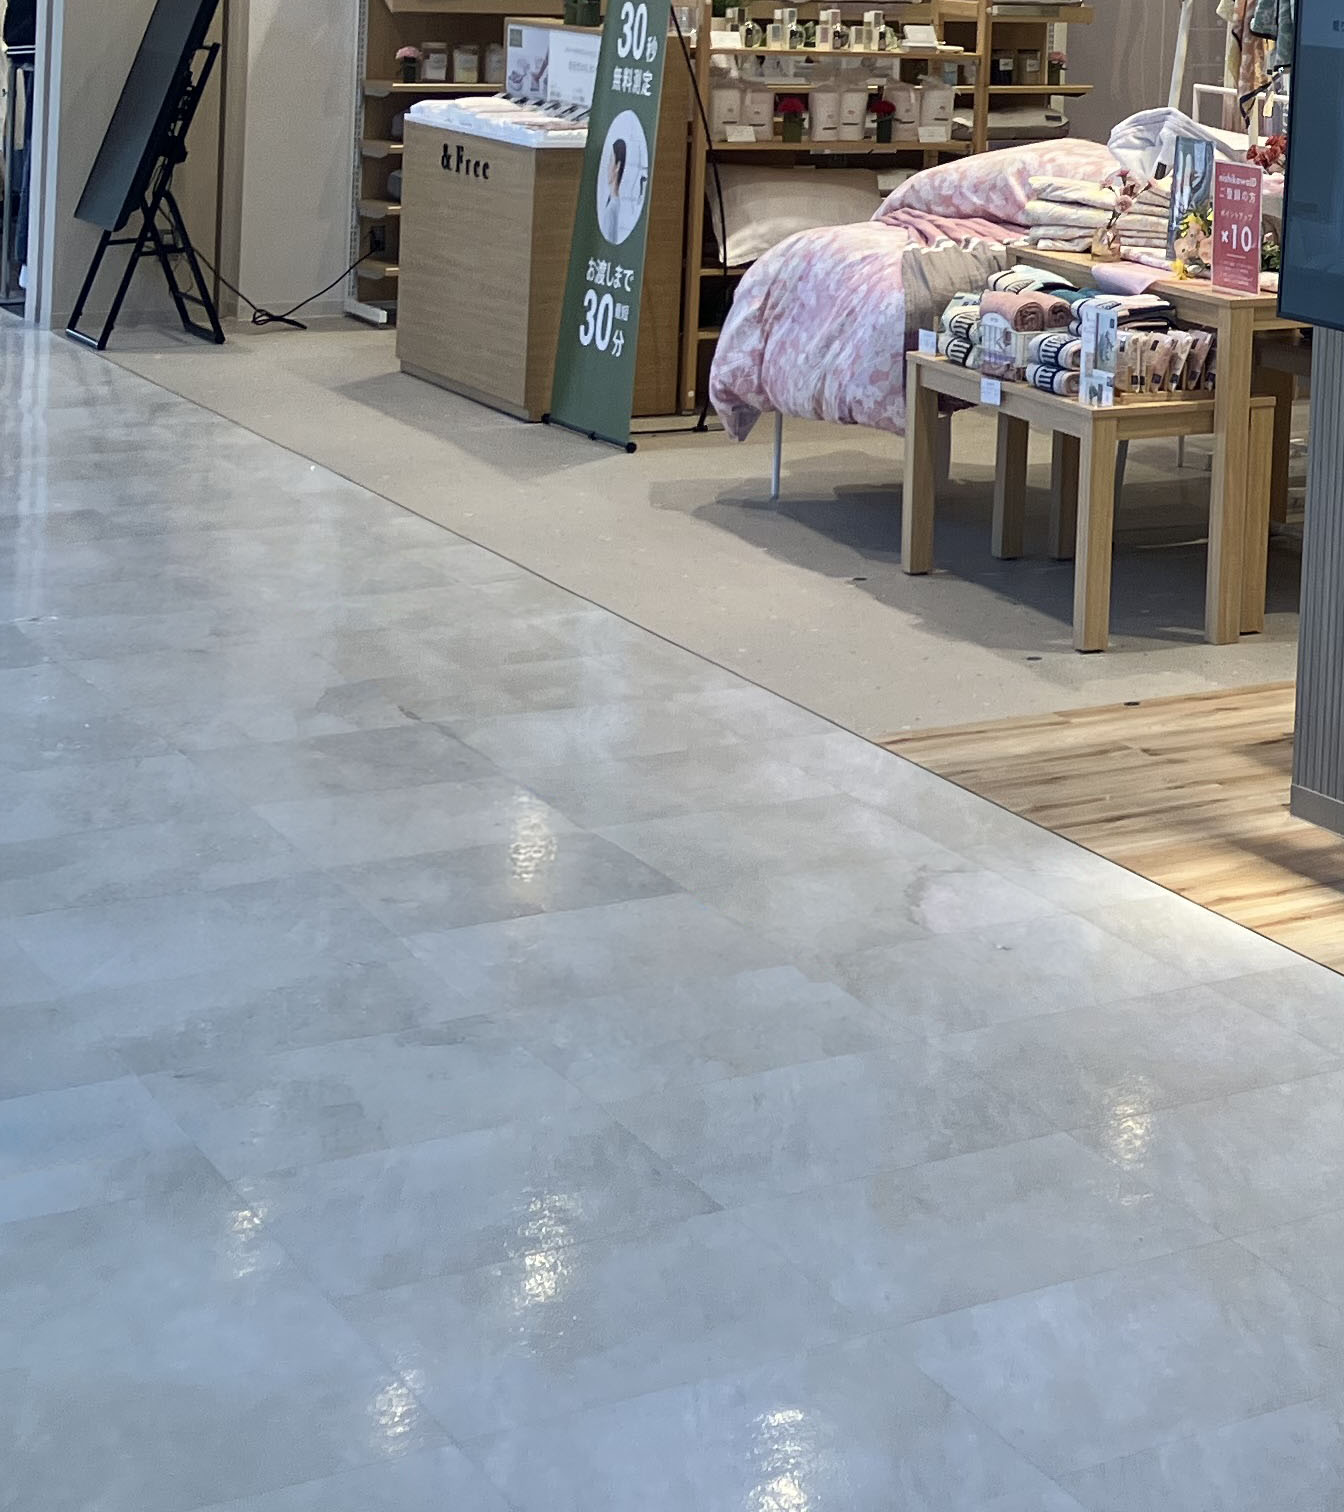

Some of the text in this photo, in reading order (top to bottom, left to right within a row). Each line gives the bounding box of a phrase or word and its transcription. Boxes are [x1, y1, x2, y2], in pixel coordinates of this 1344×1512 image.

[586, 257, 634, 292] お渡しまで
